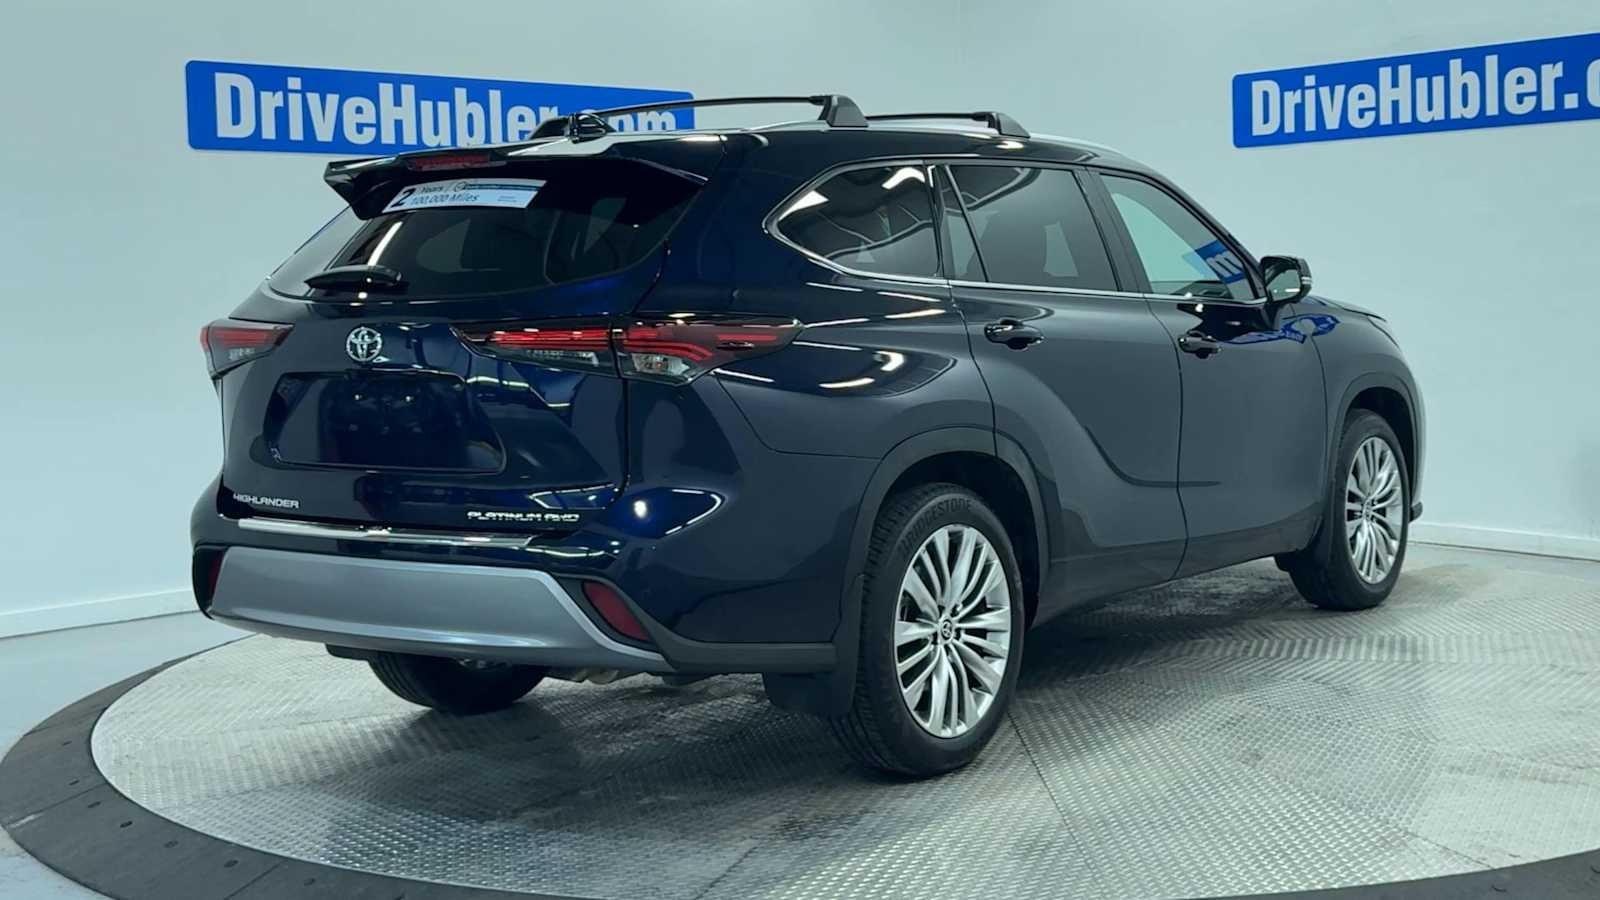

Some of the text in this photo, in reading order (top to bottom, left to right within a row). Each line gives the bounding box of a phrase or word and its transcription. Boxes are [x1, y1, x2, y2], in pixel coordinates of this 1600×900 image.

[391, 188, 417, 208] 2
[232, 492, 300, 508] HIGHLANDER
[467, 511, 541, 521] PLATINUM
[900, 498, 972, 556] BRIDGESTONE
